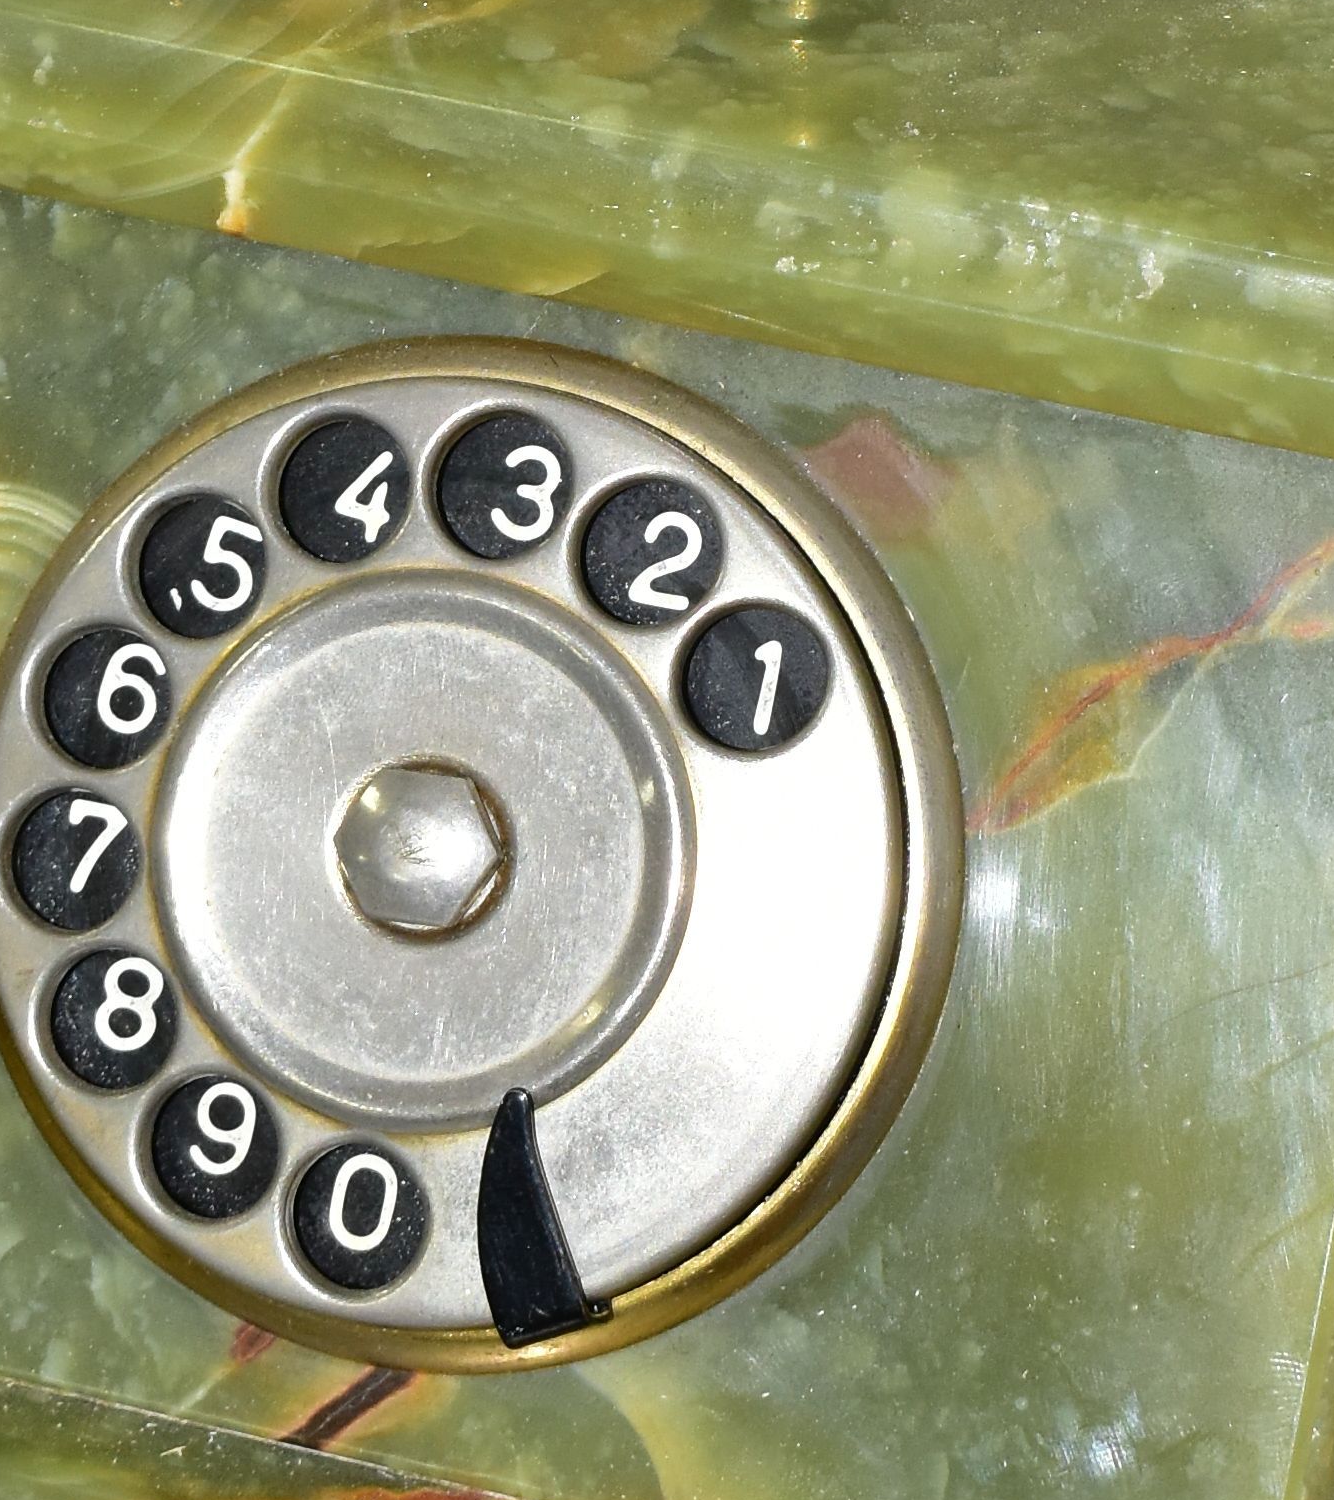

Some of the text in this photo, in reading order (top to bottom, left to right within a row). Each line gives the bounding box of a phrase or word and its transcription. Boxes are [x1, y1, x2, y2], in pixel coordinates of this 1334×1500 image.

[335, 451, 393, 542] 4
[491, 445, 562, 542] 3
[191, 516, 263, 611] 5
[628, 512, 702, 610] 2
[97, 644, 163, 734] 6
[753, 640, 782, 735] 1
[69, 799, 128, 893] 7
[94, 957, 163, 1051] 8
[190, 1082, 256, 1175] 9
[329, 1153, 397, 1251] 0
